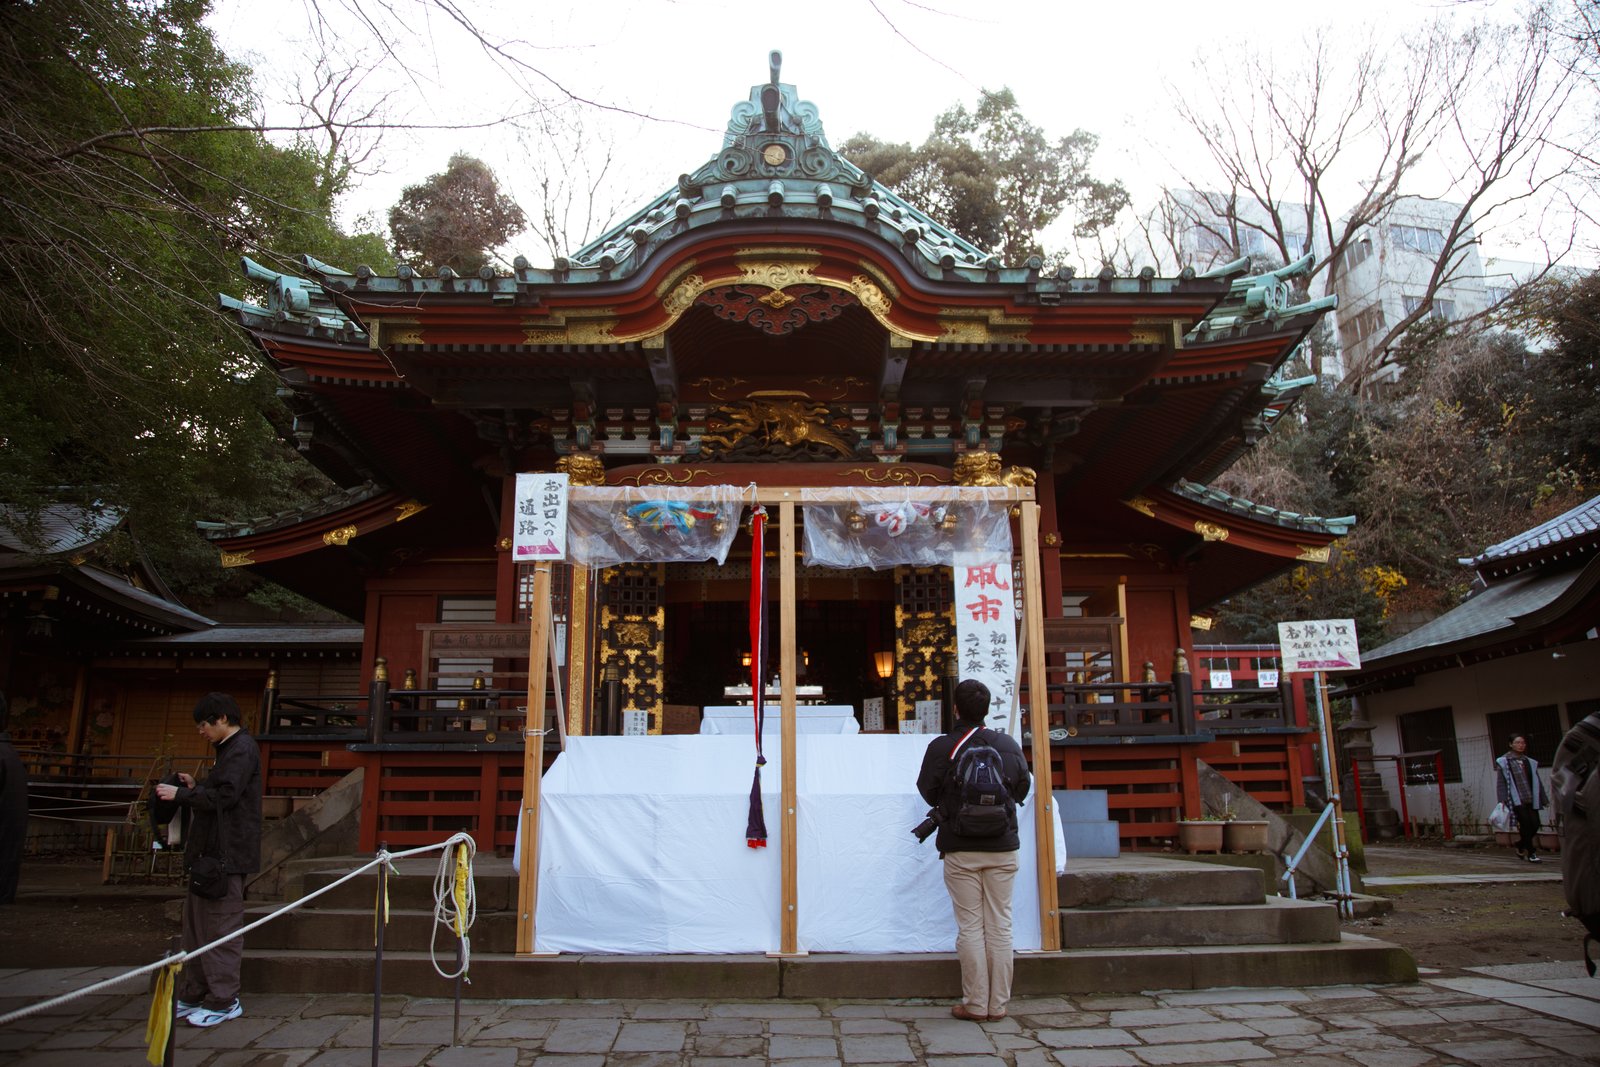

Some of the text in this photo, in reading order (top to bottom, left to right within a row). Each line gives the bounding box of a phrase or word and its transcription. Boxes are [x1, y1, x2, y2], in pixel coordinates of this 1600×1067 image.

[518, 498, 539, 536] 通路
[542, 479, 563, 537] お出口への
